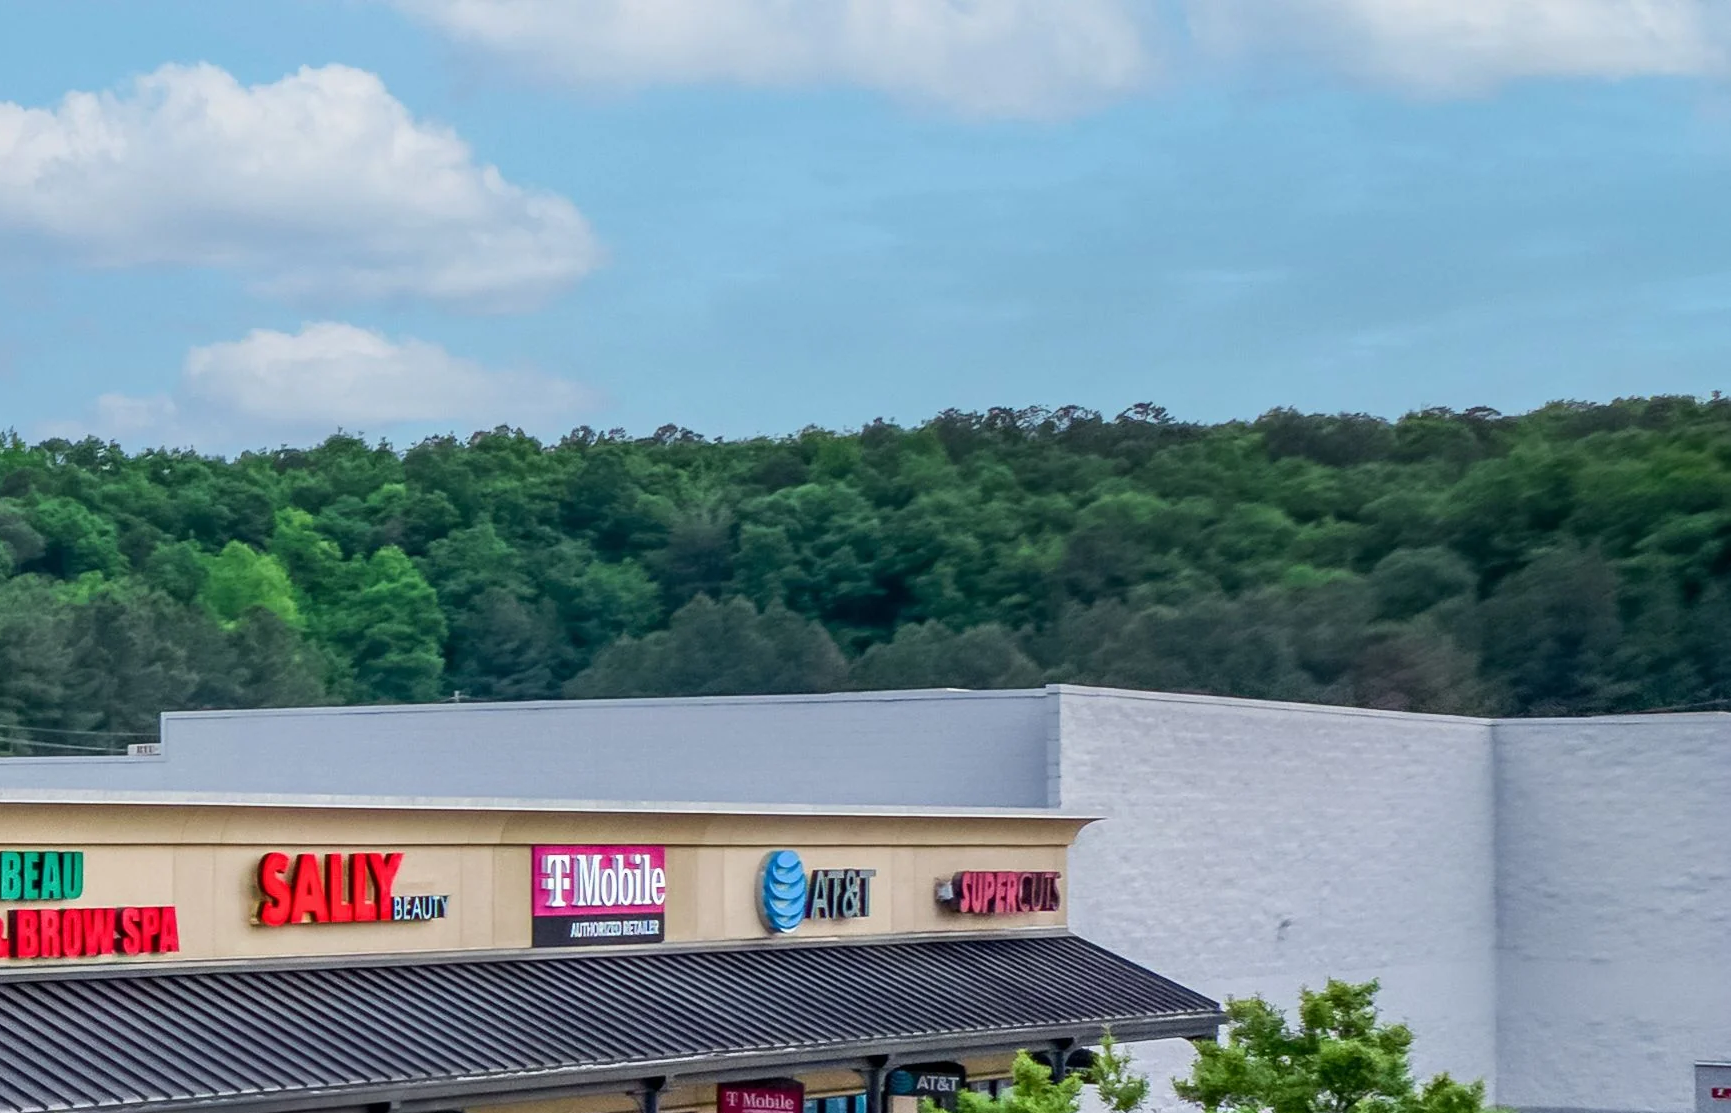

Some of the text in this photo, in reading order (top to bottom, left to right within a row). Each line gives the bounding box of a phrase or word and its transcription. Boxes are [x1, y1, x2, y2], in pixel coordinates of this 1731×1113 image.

[259, 852, 405, 927] SALLY
[573, 853, 666, 907] Mobile
[806, 869, 876, 919] AT&T
[960, 871, 1062, 913] SUPERCUTS
[394, 895, 449, 921] BEAUTY
[11, 908, 117, 958] BROW
[121, 906, 180, 955] SPA
[742, 1092, 795, 1110] Mobile
[917, 1074, 960, 1092] AT&T
